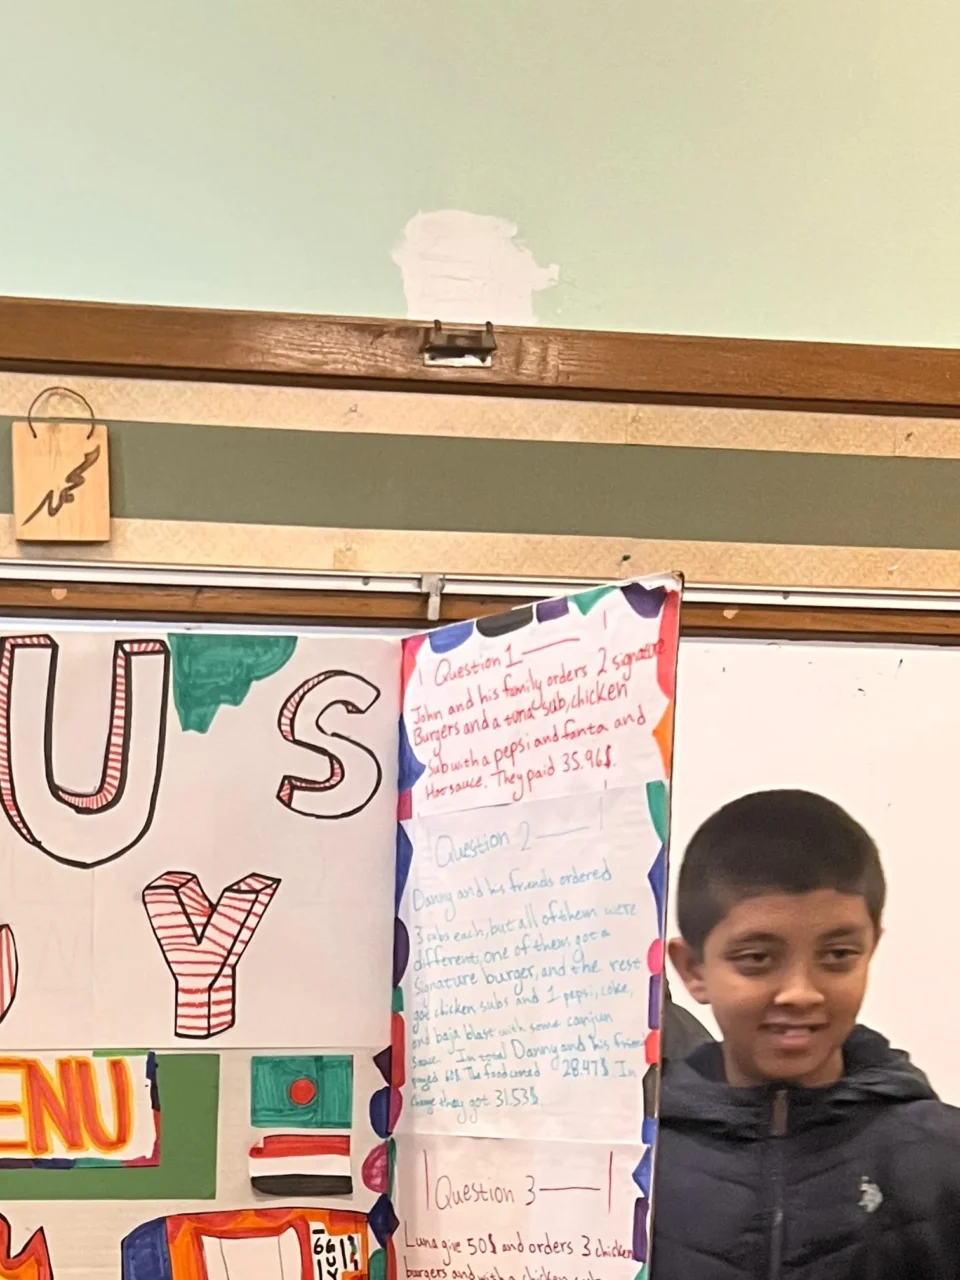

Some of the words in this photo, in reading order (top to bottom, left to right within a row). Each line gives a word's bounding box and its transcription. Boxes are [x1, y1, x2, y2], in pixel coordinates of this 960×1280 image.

[411, 706, 442, 724] John
[448, 692, 474, 714] and
[479, 685, 500, 704] his
[547, 663, 587, 687] orders
[597, 647, 608, 676] 2
[434, 657, 501, 686] Question
[491, 769, 524, 800] They
[527, 758, 556, 783] paid
[435, 829, 509, 868] Question
[520, 821, 531, 851] 2
[509, 867, 554, 893] friends
[560, 858, 612, 885] ordered
[435, 1175, 514, 1210] Question
[525, 1175, 536, 1206] 3
[314, 1237, 324, 1255] 6
[529, 1232, 573, 1256] orders
[581, 1235, 590, 1256] 3
